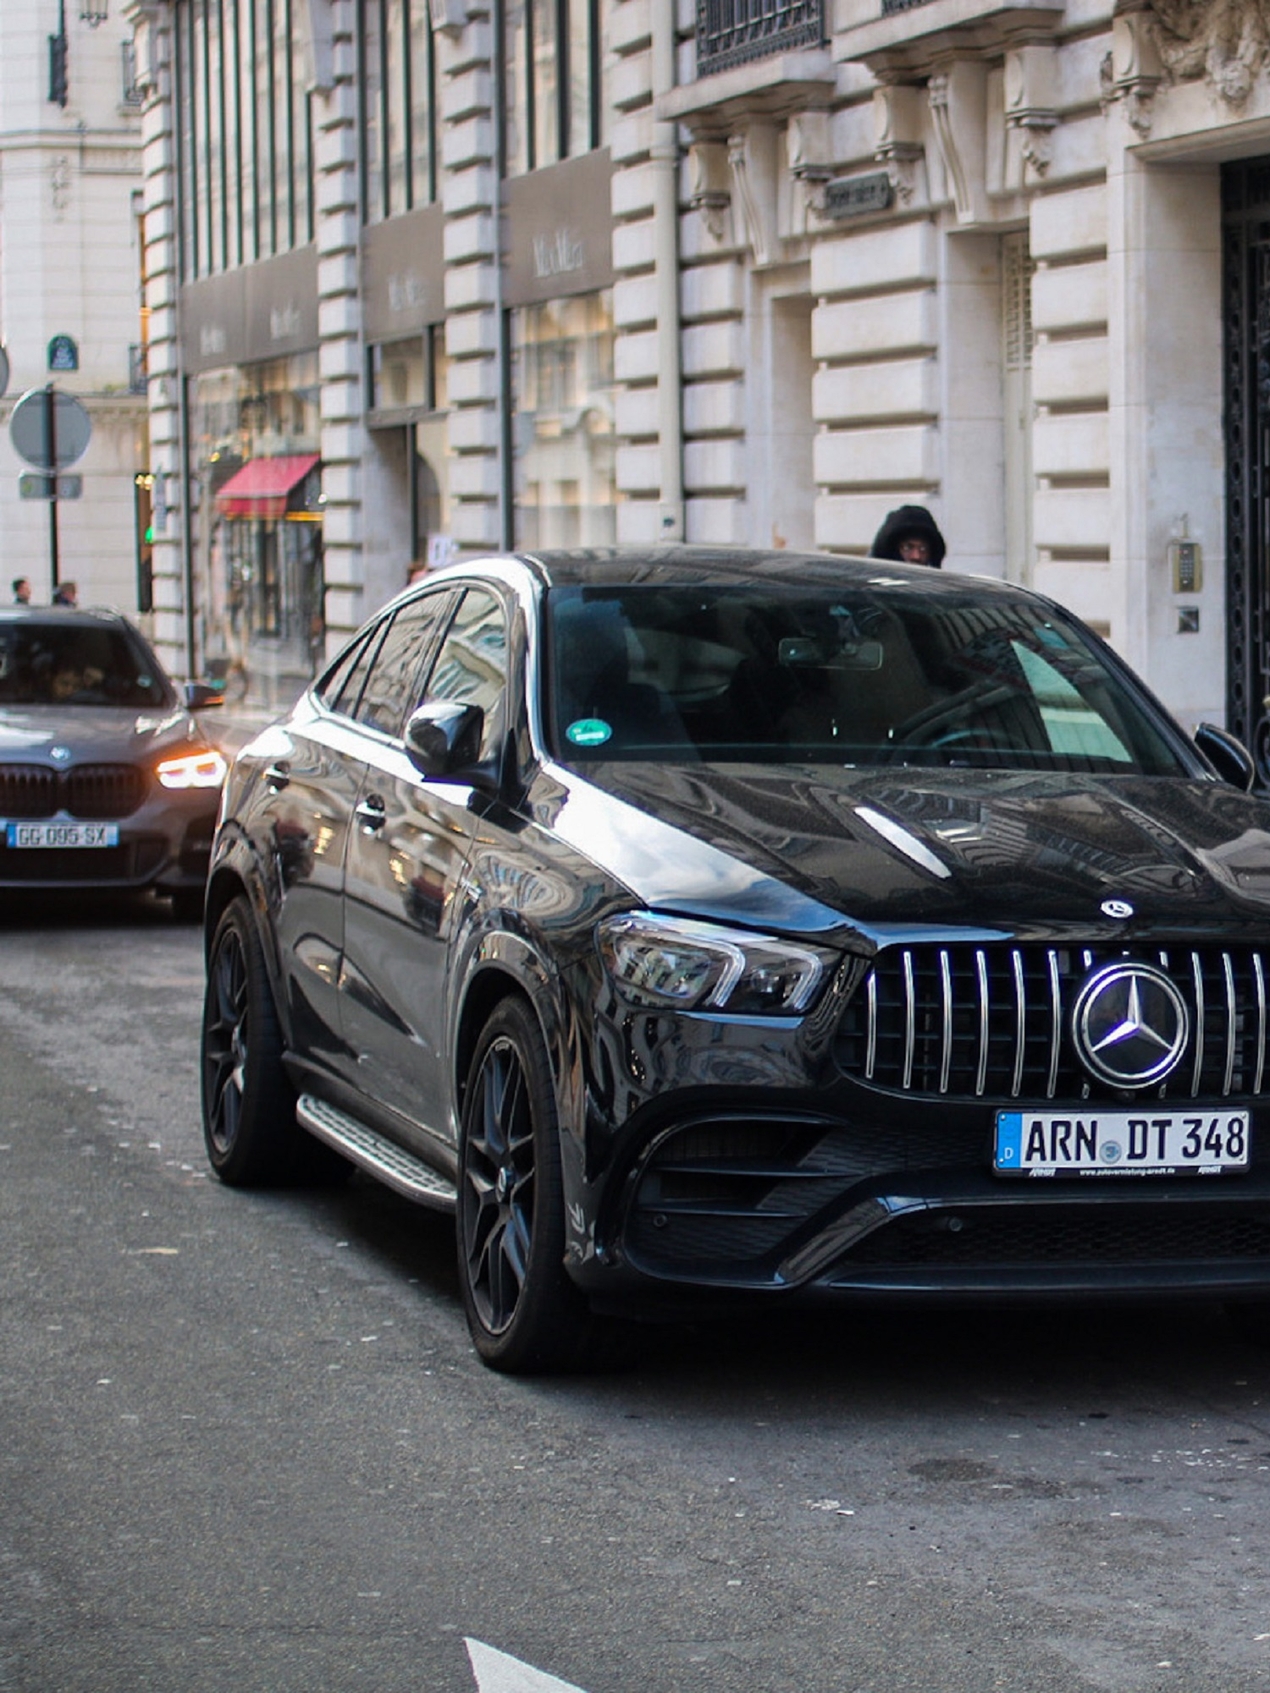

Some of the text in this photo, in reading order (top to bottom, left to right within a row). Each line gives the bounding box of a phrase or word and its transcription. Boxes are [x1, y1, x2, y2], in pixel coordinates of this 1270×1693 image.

[1024, 1120, 1098, 1162] ARN
[1126, 1119, 1172, 1161] DT
[1181, 1116, 1245, 1158] 348
